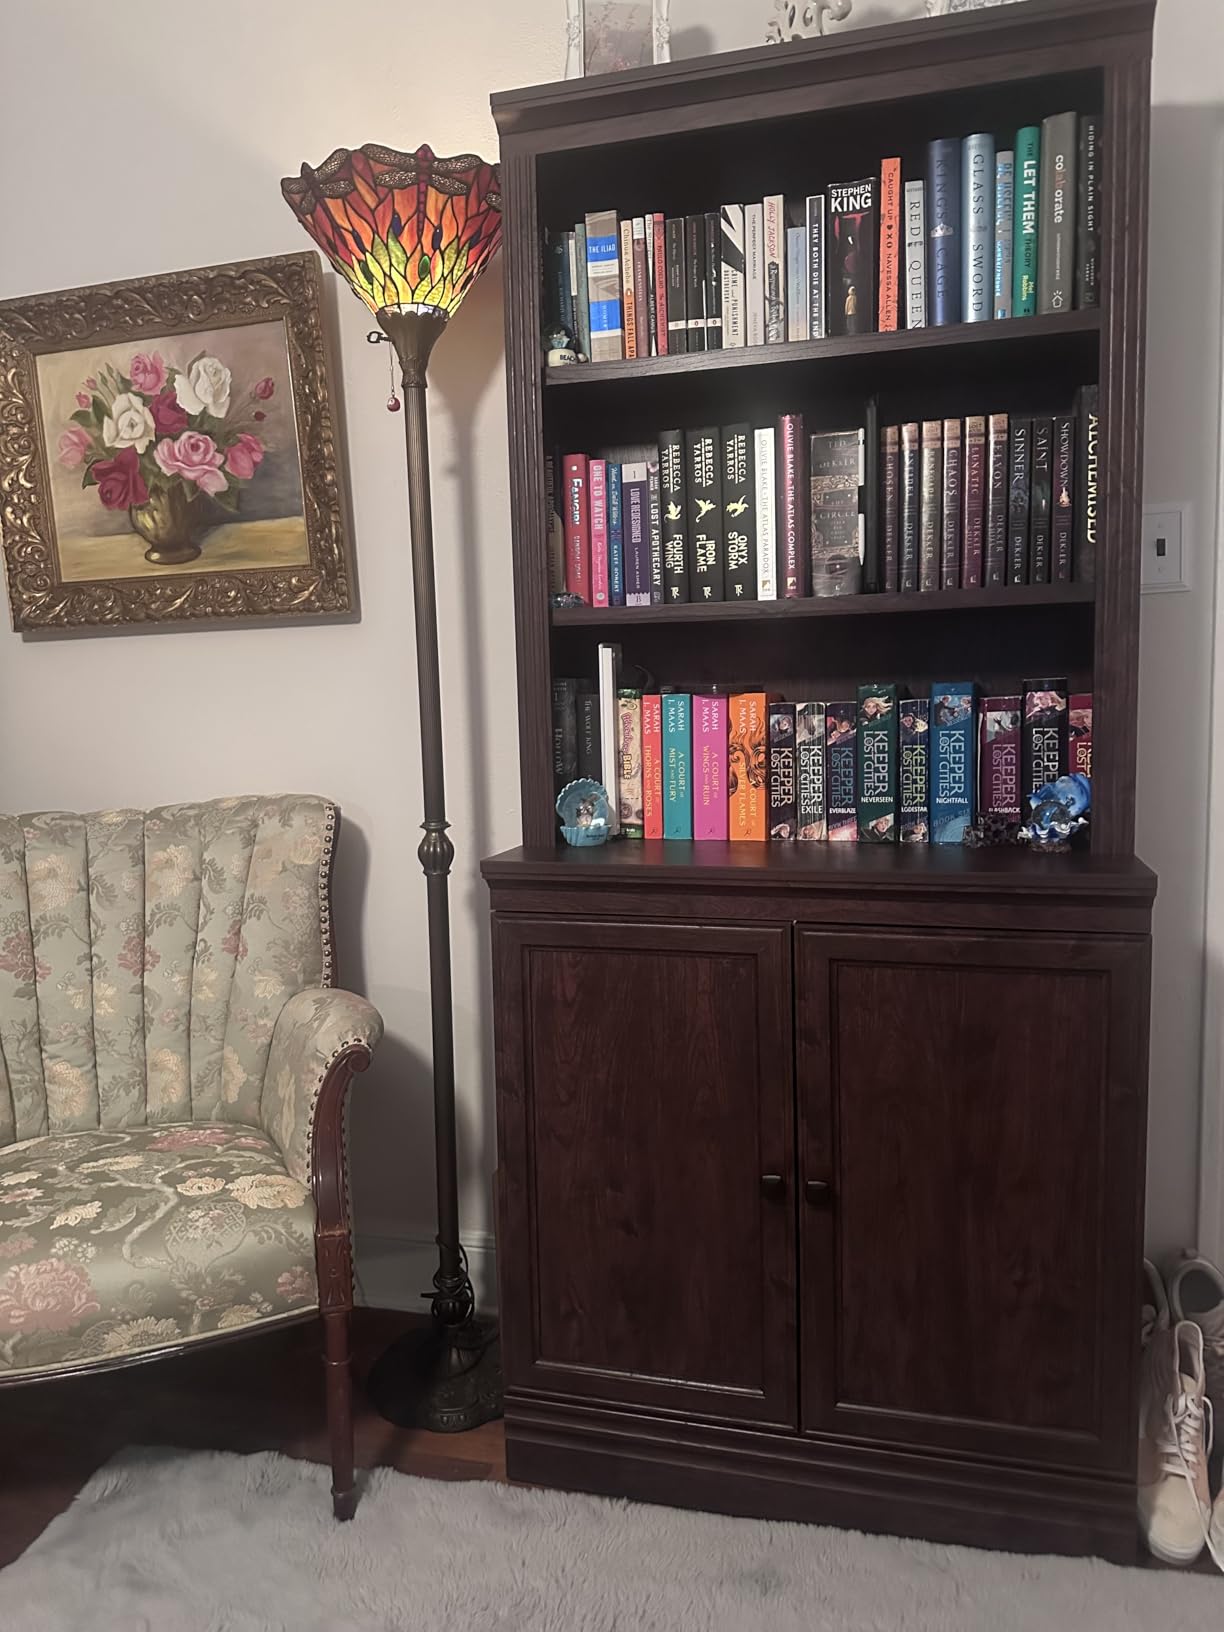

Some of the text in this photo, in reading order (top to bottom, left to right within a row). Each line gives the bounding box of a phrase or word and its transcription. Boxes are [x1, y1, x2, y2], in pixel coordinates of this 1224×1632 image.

[1087, 125, 1095, 158] HIDING
[1023, 160, 1036, 186] LET
[1087, 161, 1094, 171] IN
[831, 184, 872, 198] STEPHEN
[831, 193, 872, 213] KING
[767, 201, 777, 258] HOLLY JACKSON
[887, 210, 893, 221] UP
[909, 201, 920, 237] RED
[936, 159, 947, 298] KING'S CAGE
[1022, 191, 1036, 235] THEM
[589, 243, 616, 254] THE ILIAD
[972, 154, 984, 312] GLASS SWORD
[1023, 239, 1032, 268] THEORY
[812, 289, 819, 299] AT
[885, 253, 893, 321] NAVESSA ALLEN
[908, 260, 922, 329] QUEEN
[1021, 275, 1029, 301] Robbins
[626, 302, 634, 344] THINGS FALL
[731, 299, 739, 336] PUNISHMENT
[672, 444, 681, 491] REBECCA
[693, 443, 702, 483] YARROS
[704, 438, 714, 486] REBECCA
[726, 439, 735, 480] YARROS
[737, 435, 747, 482] REBECCA
[993, 445, 1003, 489] ELYON
[1013, 428, 1026, 485] SINNER
[1035, 427, 1049, 472] SAINT
[1059, 422, 1070, 487] SHOWDOWN
[661, 449, 670, 489] YARROS
[760, 467, 768, 490] BLAKE
[886, 455, 894, 501] CHOSEN
[947, 449, 959, 496] CHAOS
[971, 447, 980, 495] LUNATIC
[571, 478, 583, 525] FANGIRL
[593, 464, 604, 530] ONE TO WATCH
[650, 503, 660, 525] LOST
[786, 423, 795, 569] OLIVIE BLAKE THE ATLAS COMPLEX
[630, 488, 642, 543] LOVE REDESIGNED
[761, 514, 769, 535] ATLAS
[996, 514, 1005, 552] DEKKER
[665, 540, 674, 569] WING
[672, 534, 684, 574] FOURTH
[696, 534, 707, 573] FLAME
[704, 540, 716, 565] IRON
[728, 531, 739, 571] STORM
[738, 535, 748, 564] ONYX
[761, 536, 769, 574] PARADOX
[904, 523, 914, 560] DEKKER
[926, 521, 934, 559] DEKKER
[946, 521, 955, 558] DEKKER
[972, 518, 981, 555] DEKKER
[1013, 536, 1022, 570] DEKKER
[1035, 535, 1044, 568] DEKKER
[1059, 532, 1067, 565] DEKKER
[650, 528, 661, 586] APOTHECARY
[643, 708, 651, 735] MAAS
[668, 706, 676, 733] MAAS
[677, 700, 685, 731] SARAH
[702, 706, 710, 733] MAAS
[711, 700, 719, 731] SARAH
[739, 706, 747, 734] MAAS
[749, 701, 757, 732] SARAH
[622, 753, 633, 780] BIBLE
[678, 751, 685, 759] A
[703, 745, 711, 773] WINGS
[809, 745, 823, 803] KEEPER
[863, 731, 874, 796] LOST CITIES
[874, 730, 888, 795] KEEPER
[939, 730, 950, 797] LOST CITIES
[949, 730, 965, 796] KEEPER
[1032, 728, 1043, 792] LOST CITIE
[1043, 728, 1059, 784] KEEPE
[1076, 742, 1087, 770] LOST
[654, 767, 662, 795] COURT
[669, 780, 677, 803] FURY
[678, 761, 686, 790] COURT
[711, 761, 720, 791] COURT
[771, 748, 780, 808] LOST CITIES
[780, 748, 793, 807] KEEPER
[800, 745, 811, 806] LOST CITIES
[831, 748, 841, 808] LOST CITIES
[841, 747, 853, 806] KEEPER
[902, 745, 913, 806] LOST CITIES
[912, 745, 926, 805] KEEPER
[992, 744, 1002, 807] LOST CITIES
[1002, 743, 1016, 807] KEEPER
[645, 790, 653, 817] ROSES
[738, 791, 746, 827] FLAMES
[749, 787, 757, 817] COURT
[801, 805, 823, 814] EXILE
